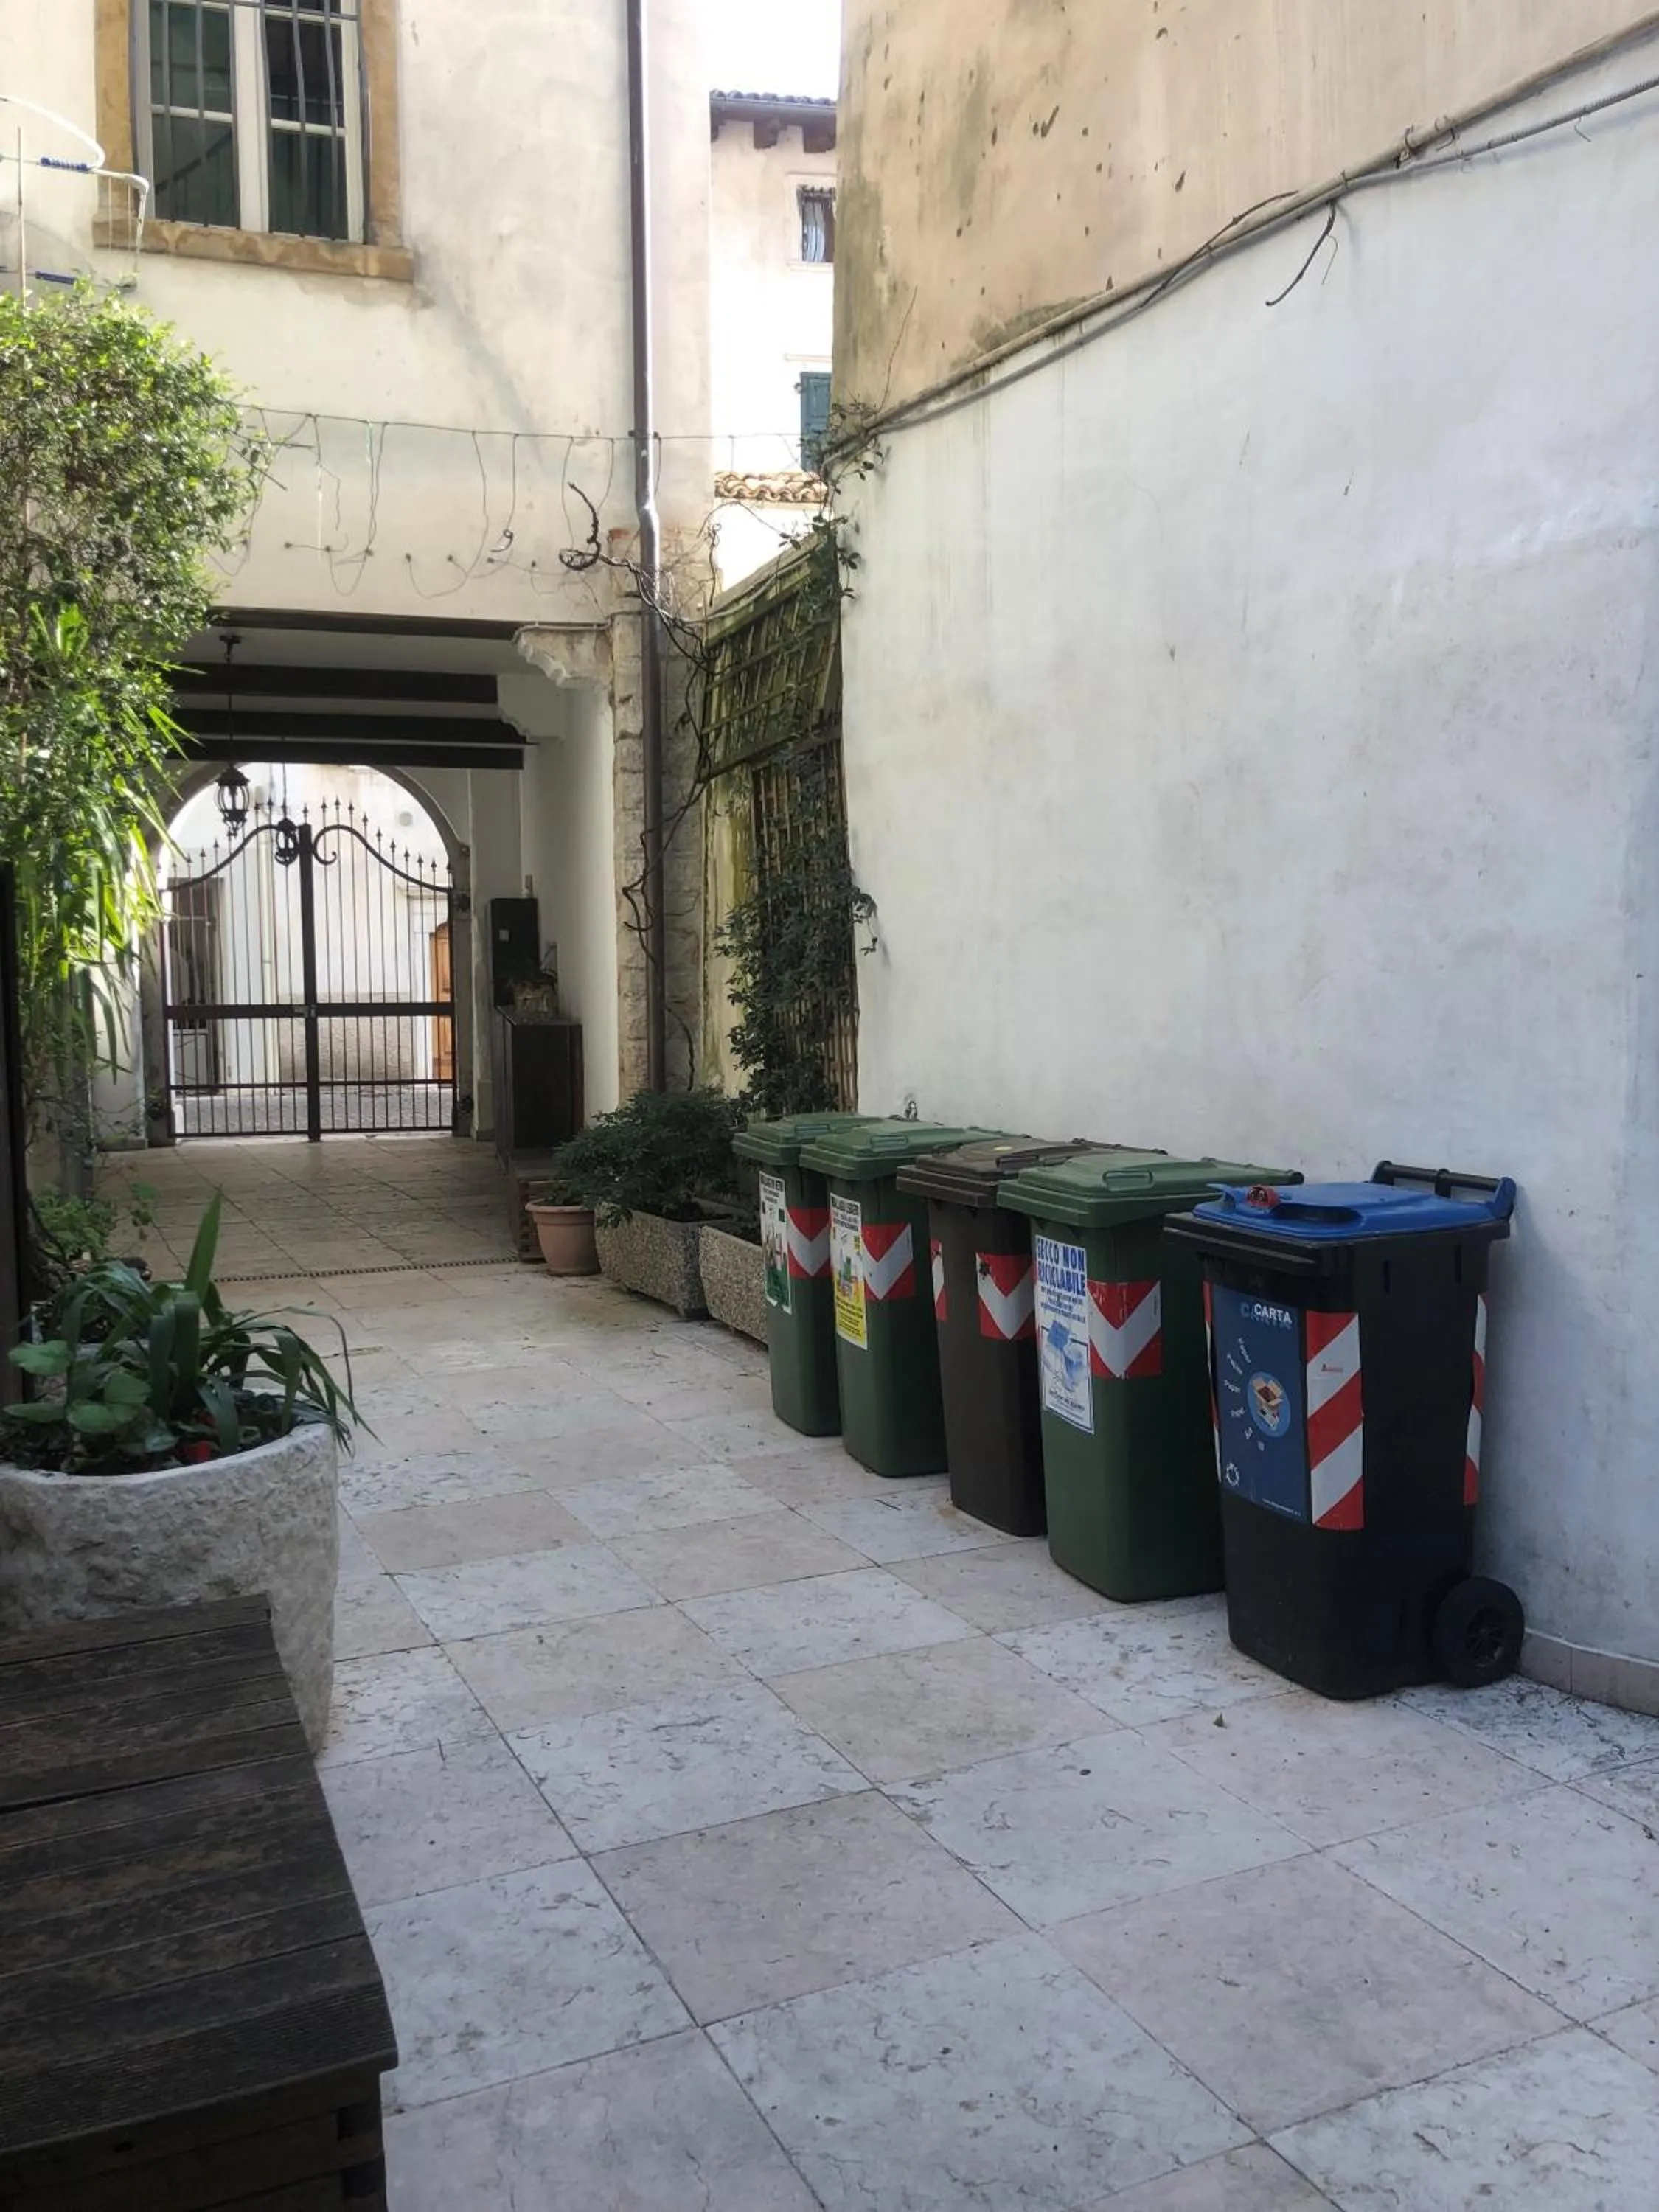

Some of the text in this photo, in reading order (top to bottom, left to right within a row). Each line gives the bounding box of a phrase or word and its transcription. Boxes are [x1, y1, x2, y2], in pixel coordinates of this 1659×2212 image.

[1062, 1245, 1085, 1272] NON
[1037, 1259, 1086, 1296] RICICLABILE
[1254, 1303, 1293, 1324] CARTA
